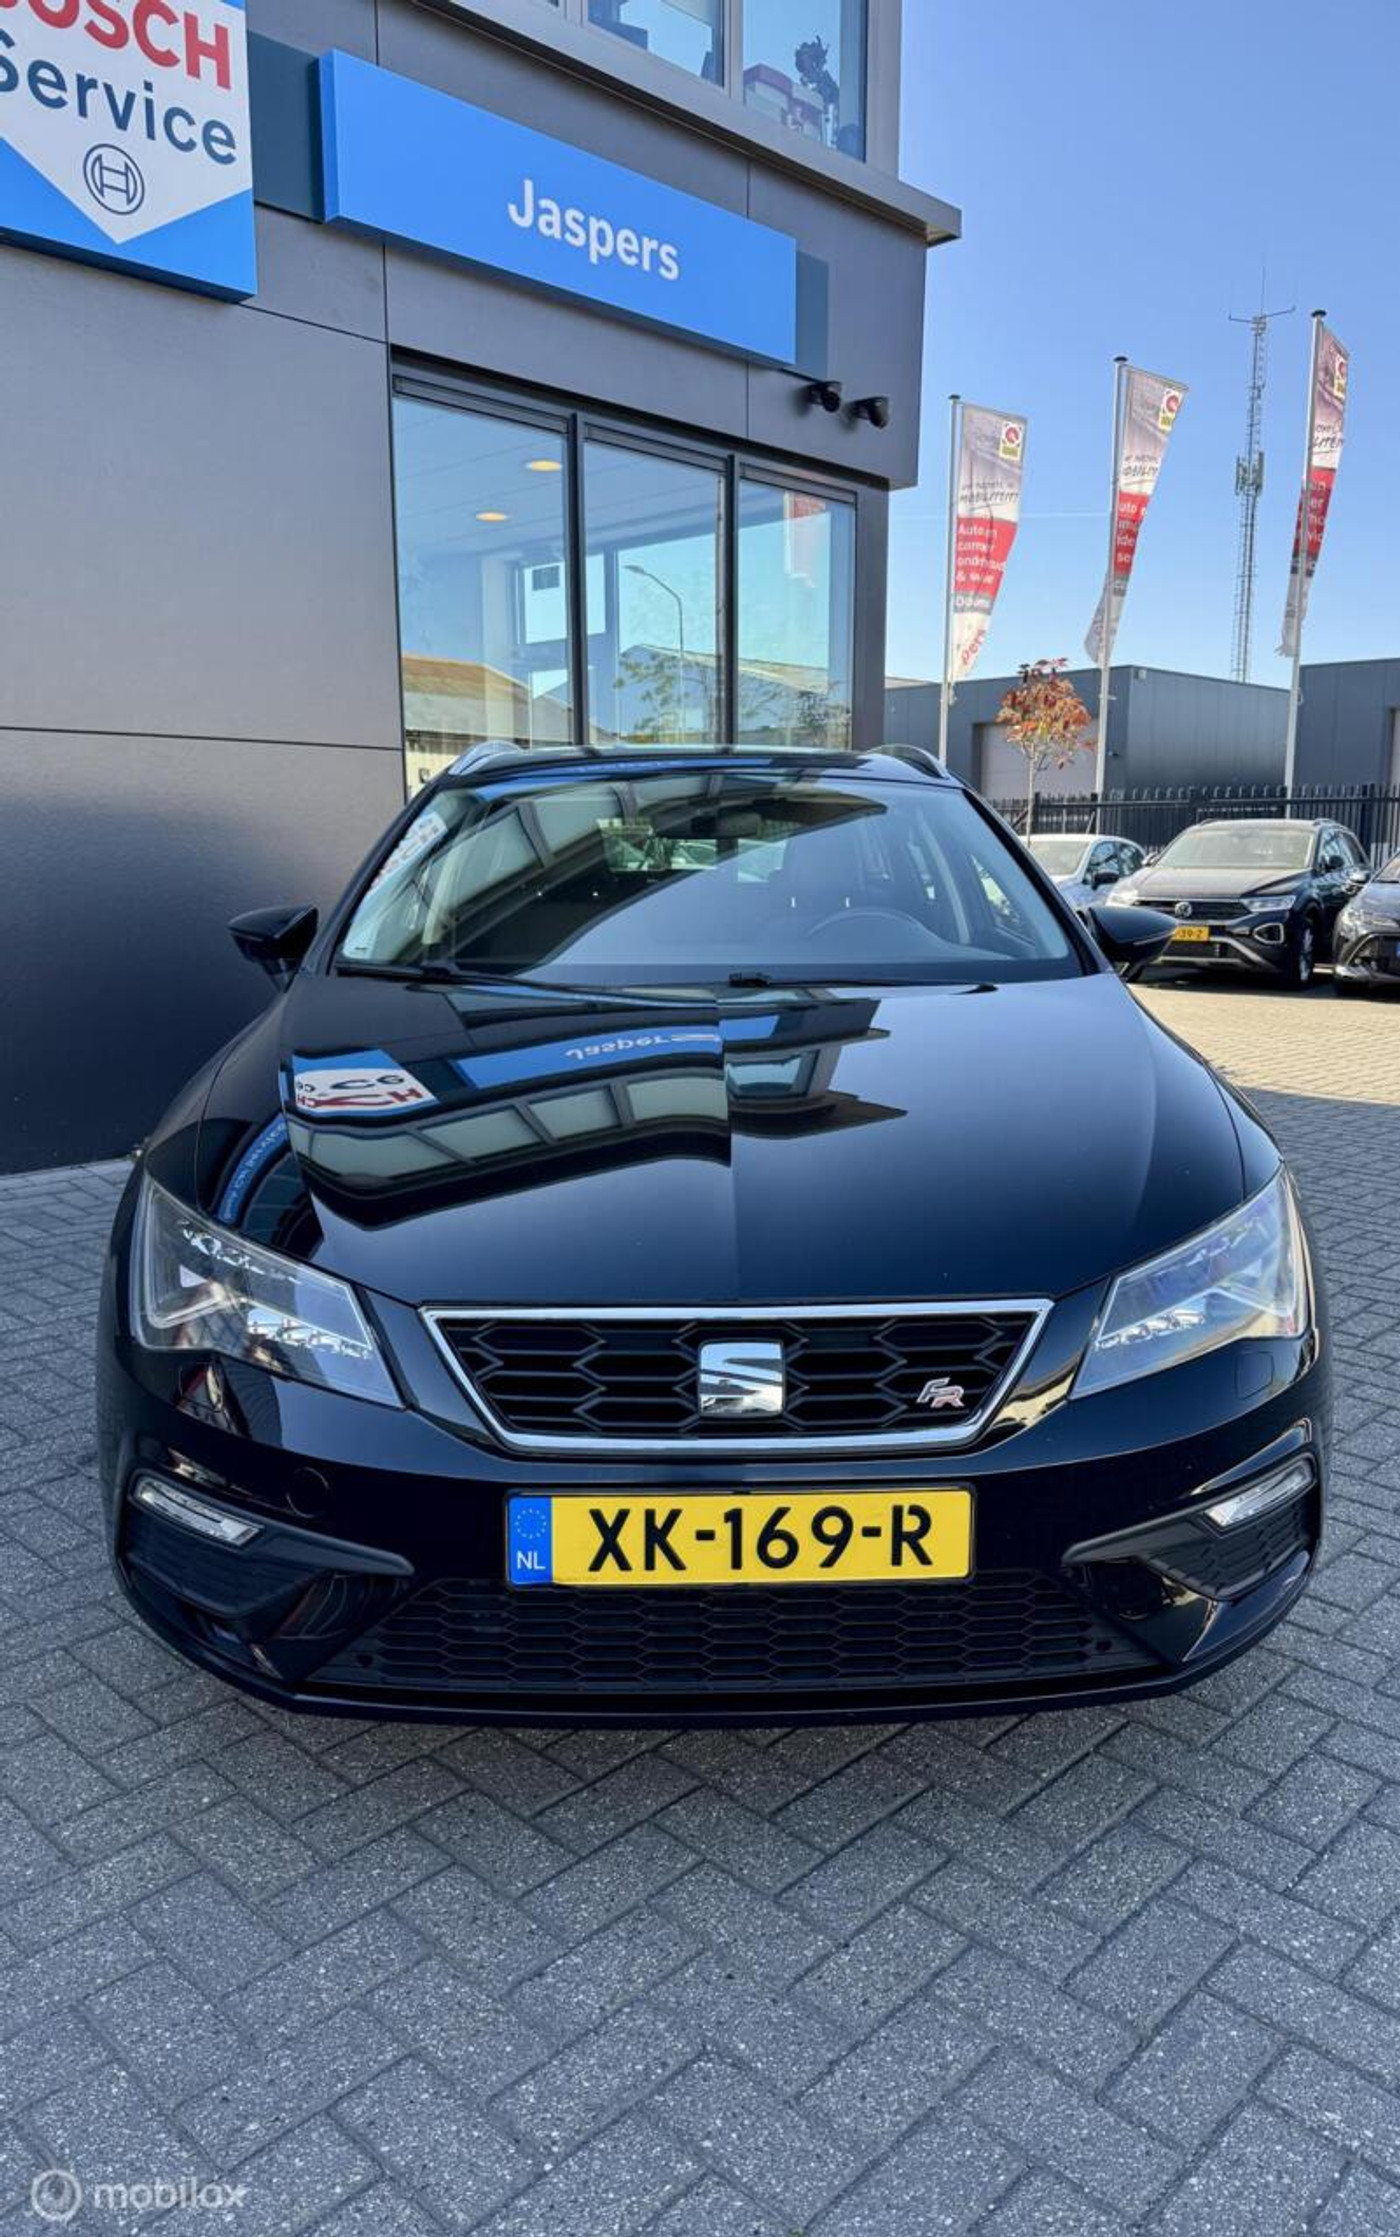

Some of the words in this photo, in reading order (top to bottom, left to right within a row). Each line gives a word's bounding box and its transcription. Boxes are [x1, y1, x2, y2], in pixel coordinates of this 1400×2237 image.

[0, 0, 231, 90] SCH
[507, 178, 680, 281] Jaspers
[915, 1376, 965, 1409] FR
[516, 1551, 546, 1571] NL
[587, 1504, 933, 1573] XK-169-R
